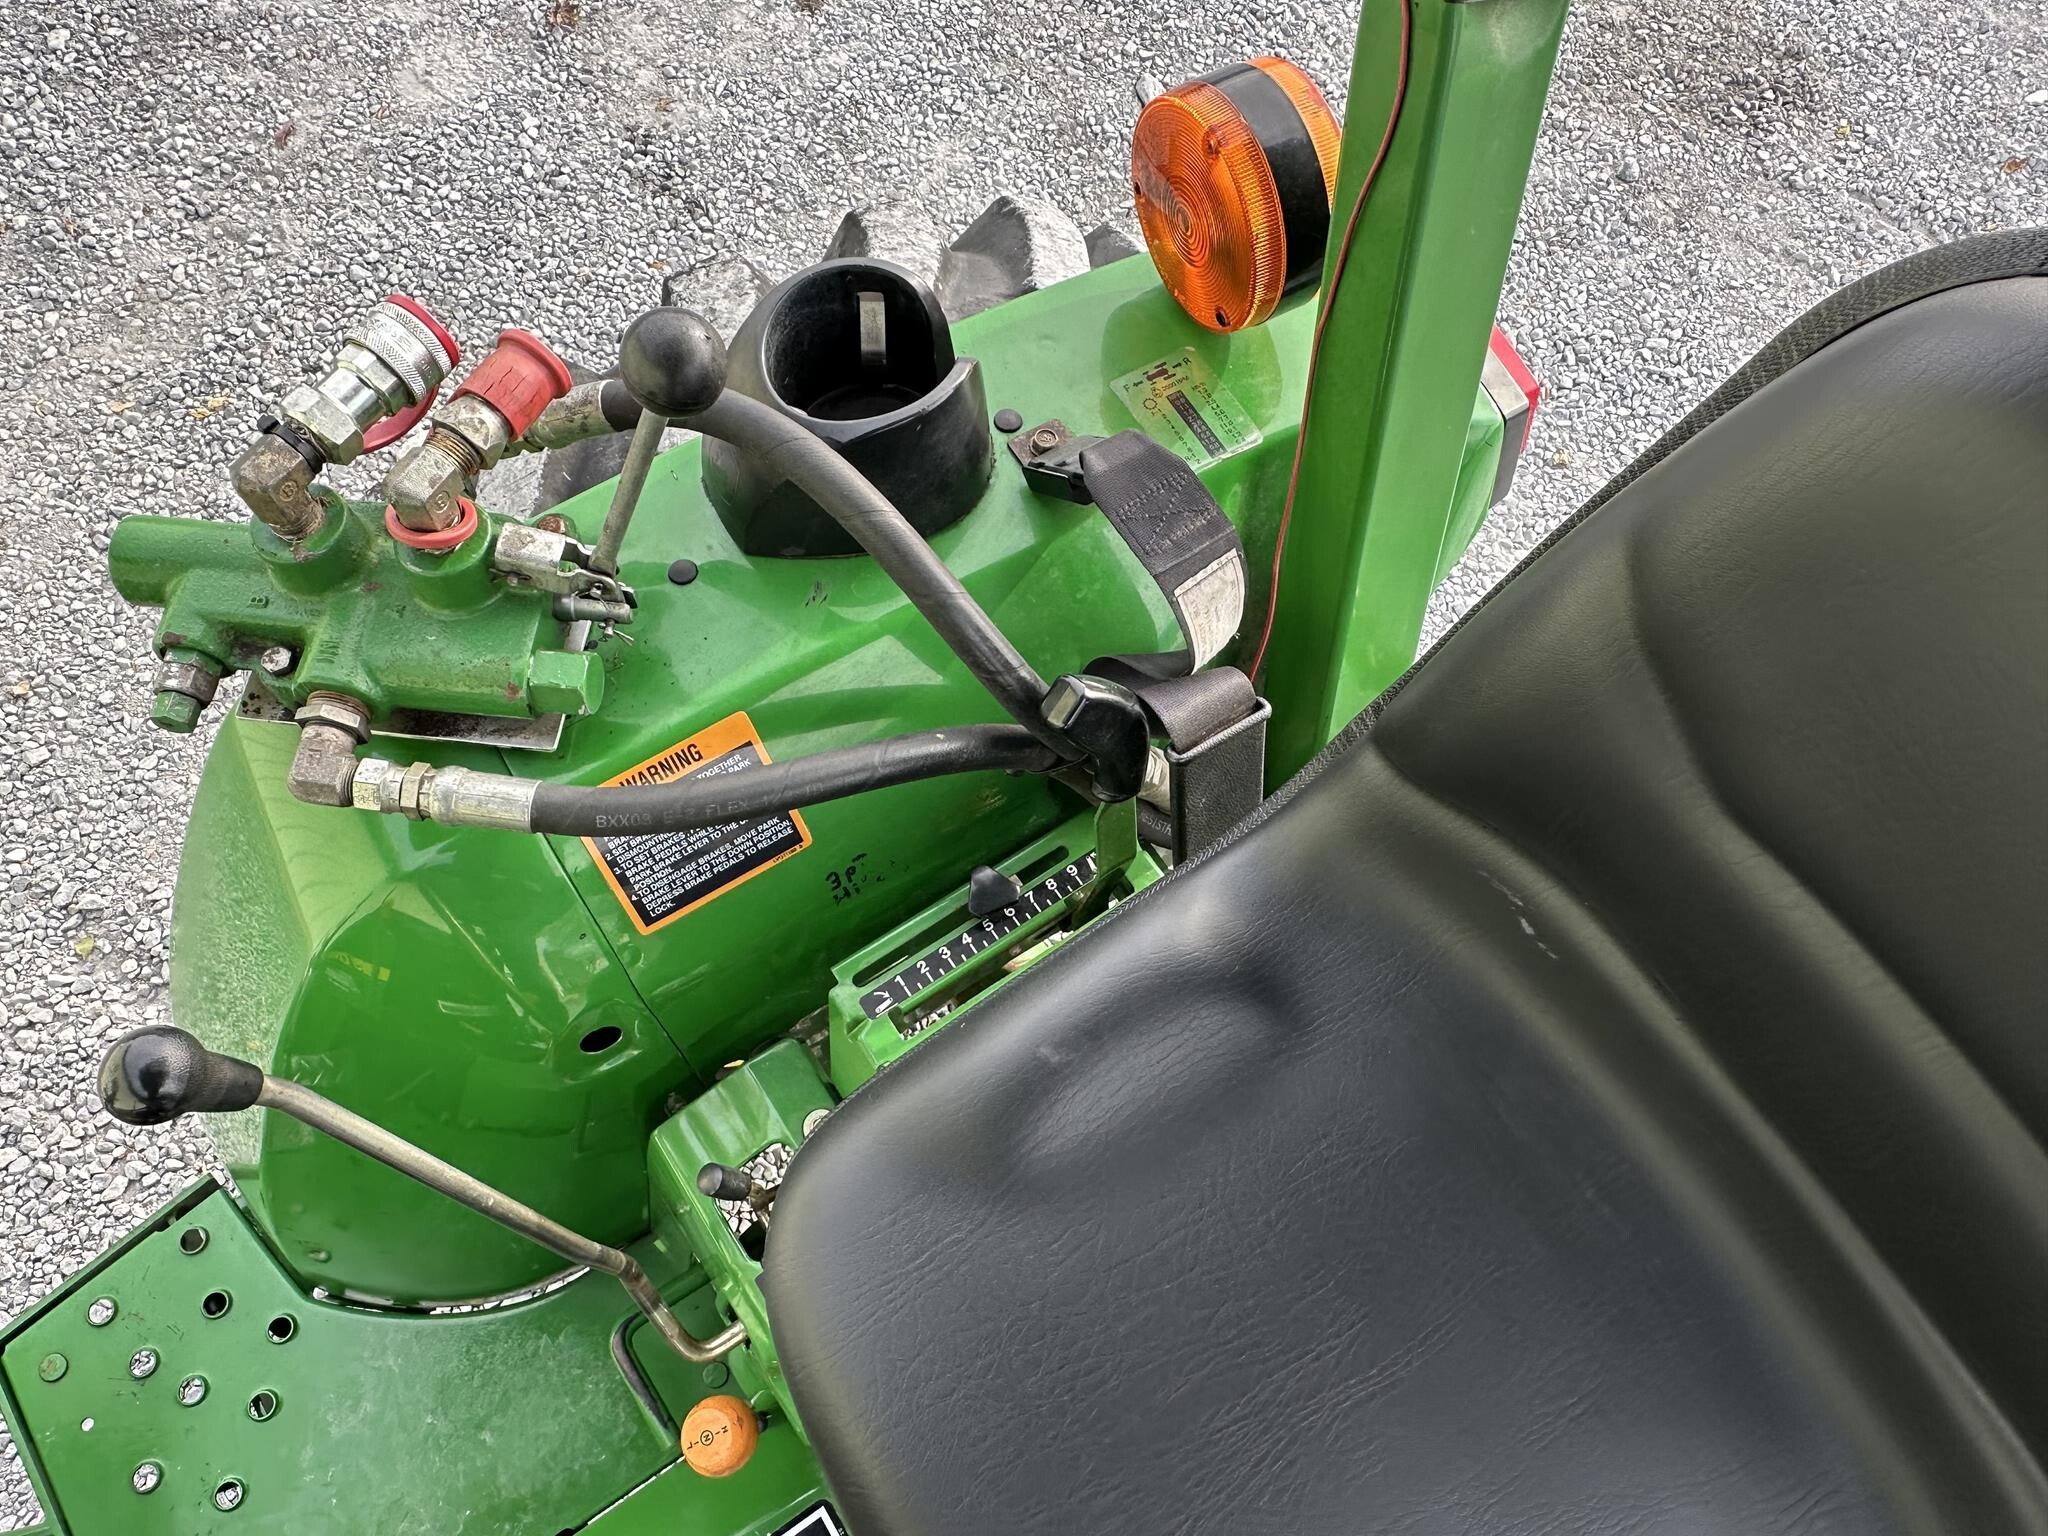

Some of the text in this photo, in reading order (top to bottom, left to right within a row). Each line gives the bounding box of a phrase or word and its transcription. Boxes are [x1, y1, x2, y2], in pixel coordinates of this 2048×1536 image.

[619, 743, 703, 786] WARNING
[611, 842, 630, 856] SET
[616, 832, 677, 864] DISMOUNTIN
[619, 859, 634, 871] TO
[633, 850, 650, 864] SET
[624, 857, 655, 878] BRAKE
[653, 839, 688, 861] PEDALS
[686, 825, 714, 844] WHILE
[628, 867, 653, 884] PARK
[652, 851, 682, 871] BRAKE
[681, 837, 709, 856] LEVER
[708, 830, 722, 841] TO
[721, 820, 738, 834] THE
[636, 886, 650, 898] TO
[649, 861, 698, 891] DISENGAGE
[732, 828, 757, 845] MOVE
[756, 816, 780, 832] PARK
[641, 884, 671, 904] BRAKE
[670, 869, 698, 888] LEVER
[697, 862, 710, 873] TO
[708, 853, 727, 867] THE
[726, 839, 753, 857] DOWN
[645, 885, 684, 910] DEPRESS
[683, 869, 713, 890] BRAKE
[712, 852, 745, 874] PEDALS
[744, 845, 757, 856] TO
[756, 825, 794, 850] RELEASE
[633, 864, 675, 891] POSITION.
[649, 899, 676, 917] LOCK.
[894, 864, 1078, 987] 1 2 3 4 5 6 7 8 9
